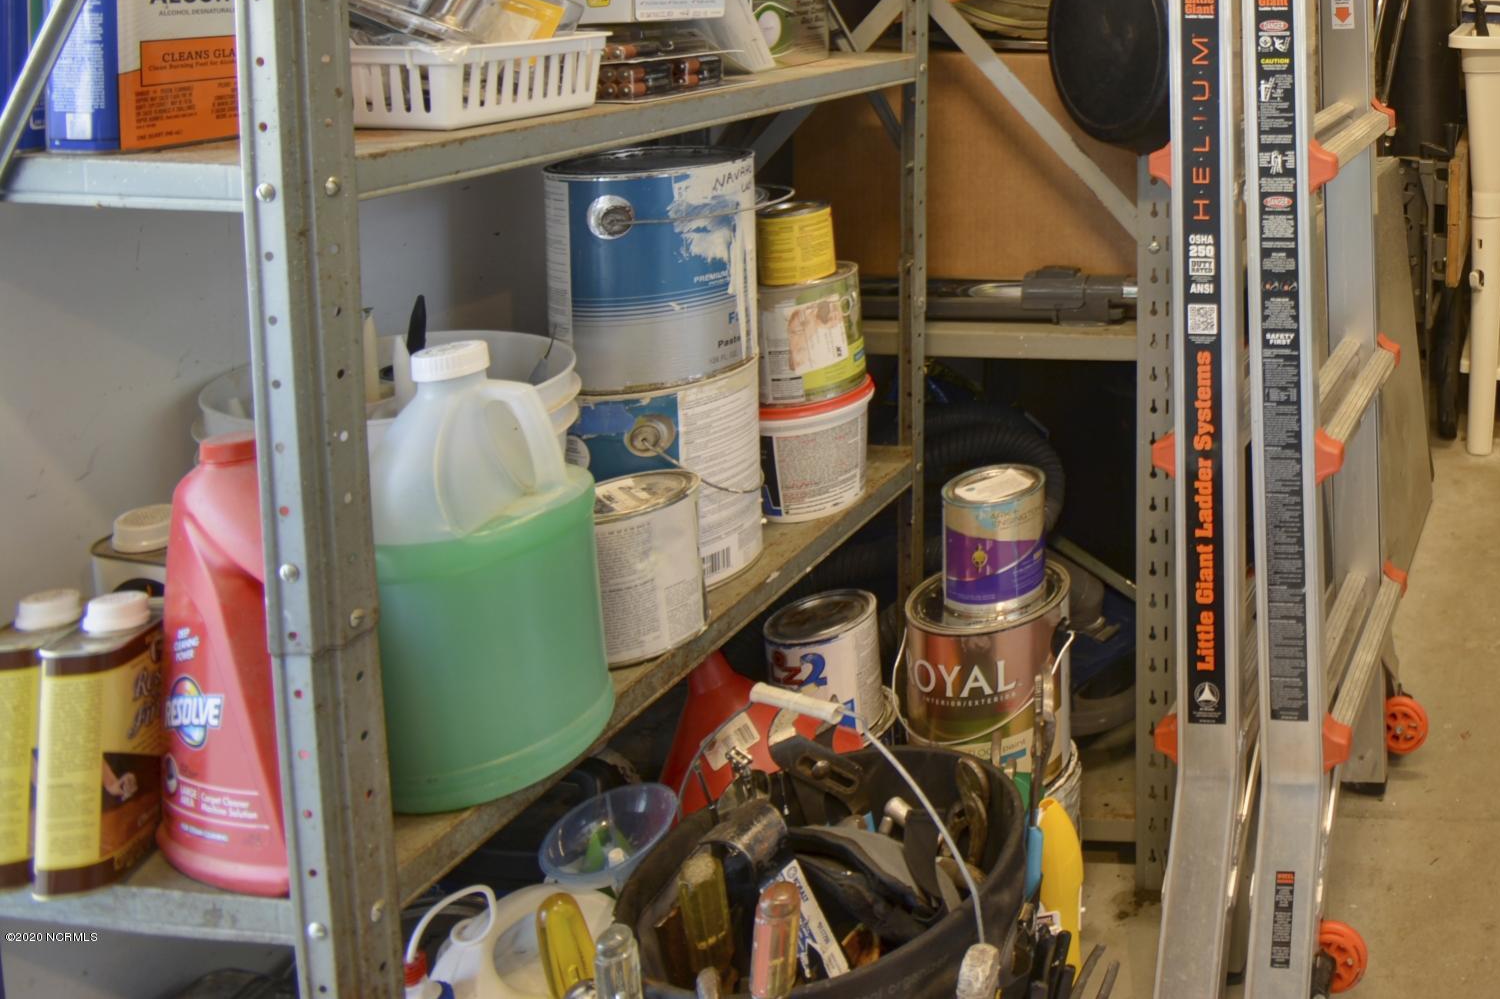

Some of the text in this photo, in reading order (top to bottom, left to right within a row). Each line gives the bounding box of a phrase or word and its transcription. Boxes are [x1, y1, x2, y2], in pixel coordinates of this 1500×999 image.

[191, 8, 234, 17] DESNATURAL
[1185, 3, 1215, 15] Giant
[162, 50, 209, 63] CLEANS
[1189, 235, 1213, 244] OSHA
[1189, 246, 1214, 257] 250
[1190, 283, 1213, 294] ANSI
[1194, 352, 1215, 671] Little Giant Ladder Systems
[166, 696, 221, 727] RESOLVE
